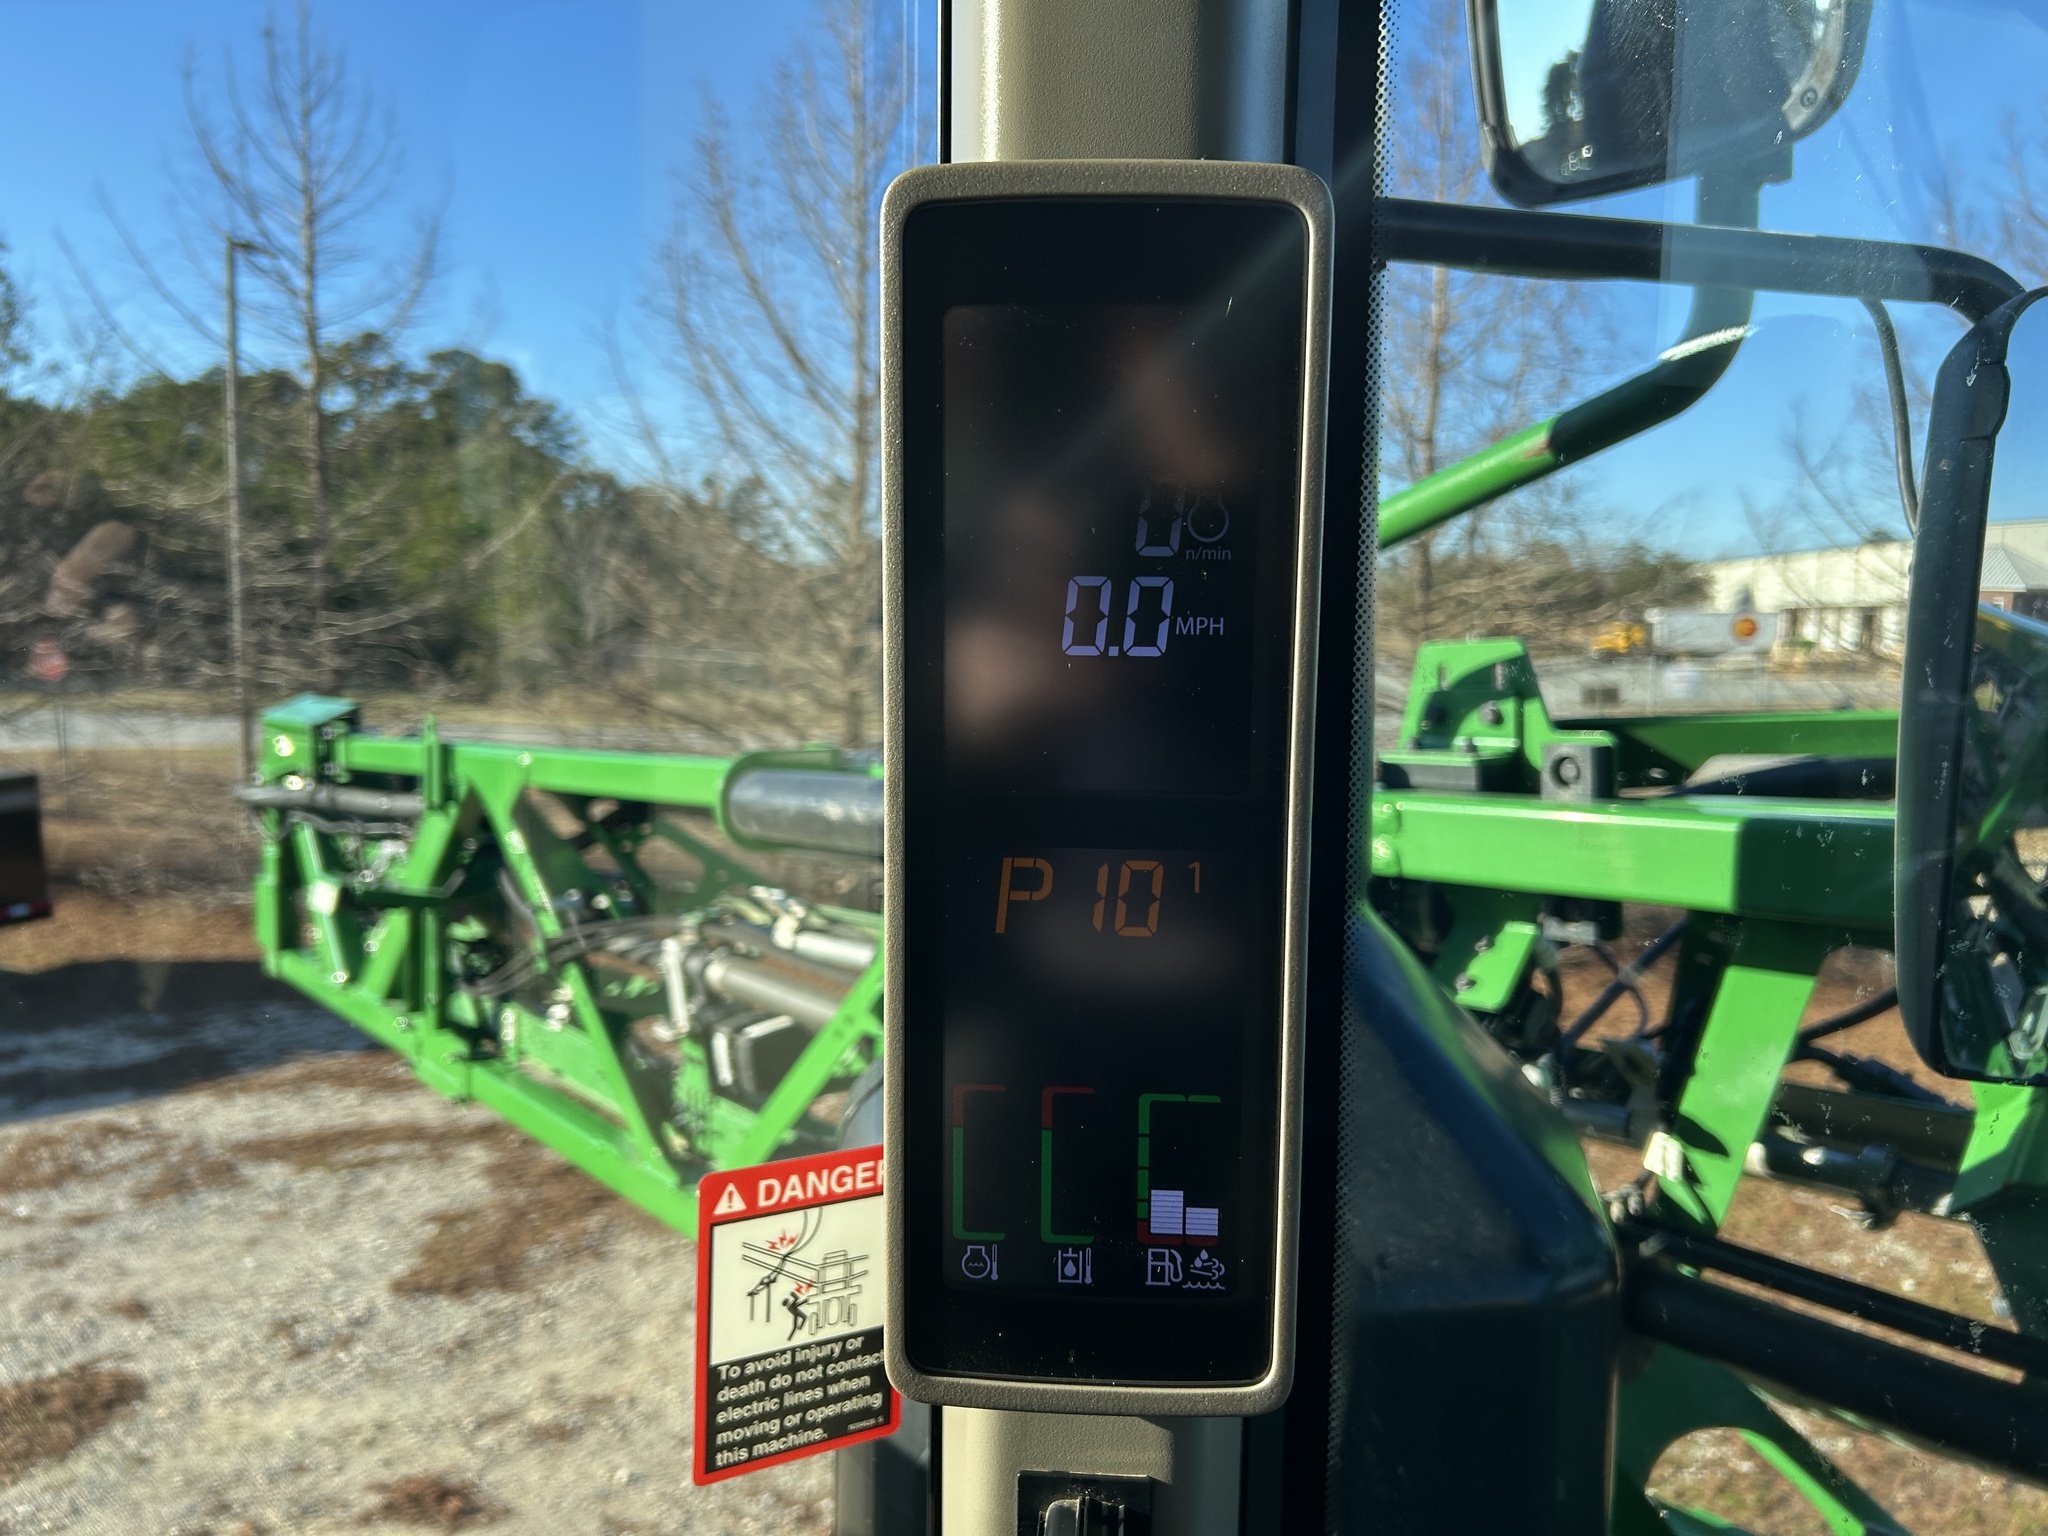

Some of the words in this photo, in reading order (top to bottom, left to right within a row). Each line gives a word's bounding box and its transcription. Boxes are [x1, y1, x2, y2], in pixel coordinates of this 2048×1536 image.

[1185, 546, 1231, 561] n/min
[1061, 575, 1174, 658] 0.0
[1175, 616, 1224, 636] MPH
[995, 857, 1053, 934] P
[1092, 860, 1164, 937] 10
[1188, 861, 1200, 894] 1
[716, 1378, 766, 1402] death
[769, 1373, 793, 1390] do
[795, 1363, 825, 1384] not
[717, 1364, 742, 1382] To
[743, 1350, 793, 1376] avoid
[795, 1340, 843, 1364] injury
[845, 1335, 865, 1351] or
[715, 1397, 781, 1425] electric
[783, 1386, 825, 1407] lines
[826, 1374, 872, 1396] when
[715, 1417, 781, 1446] moving
[783, 1412, 804, 1429] or
[805, 1391, 884, 1424] operating
[715, 1447, 750, 1468] this
[751, 1427, 828, 1458] machine.
